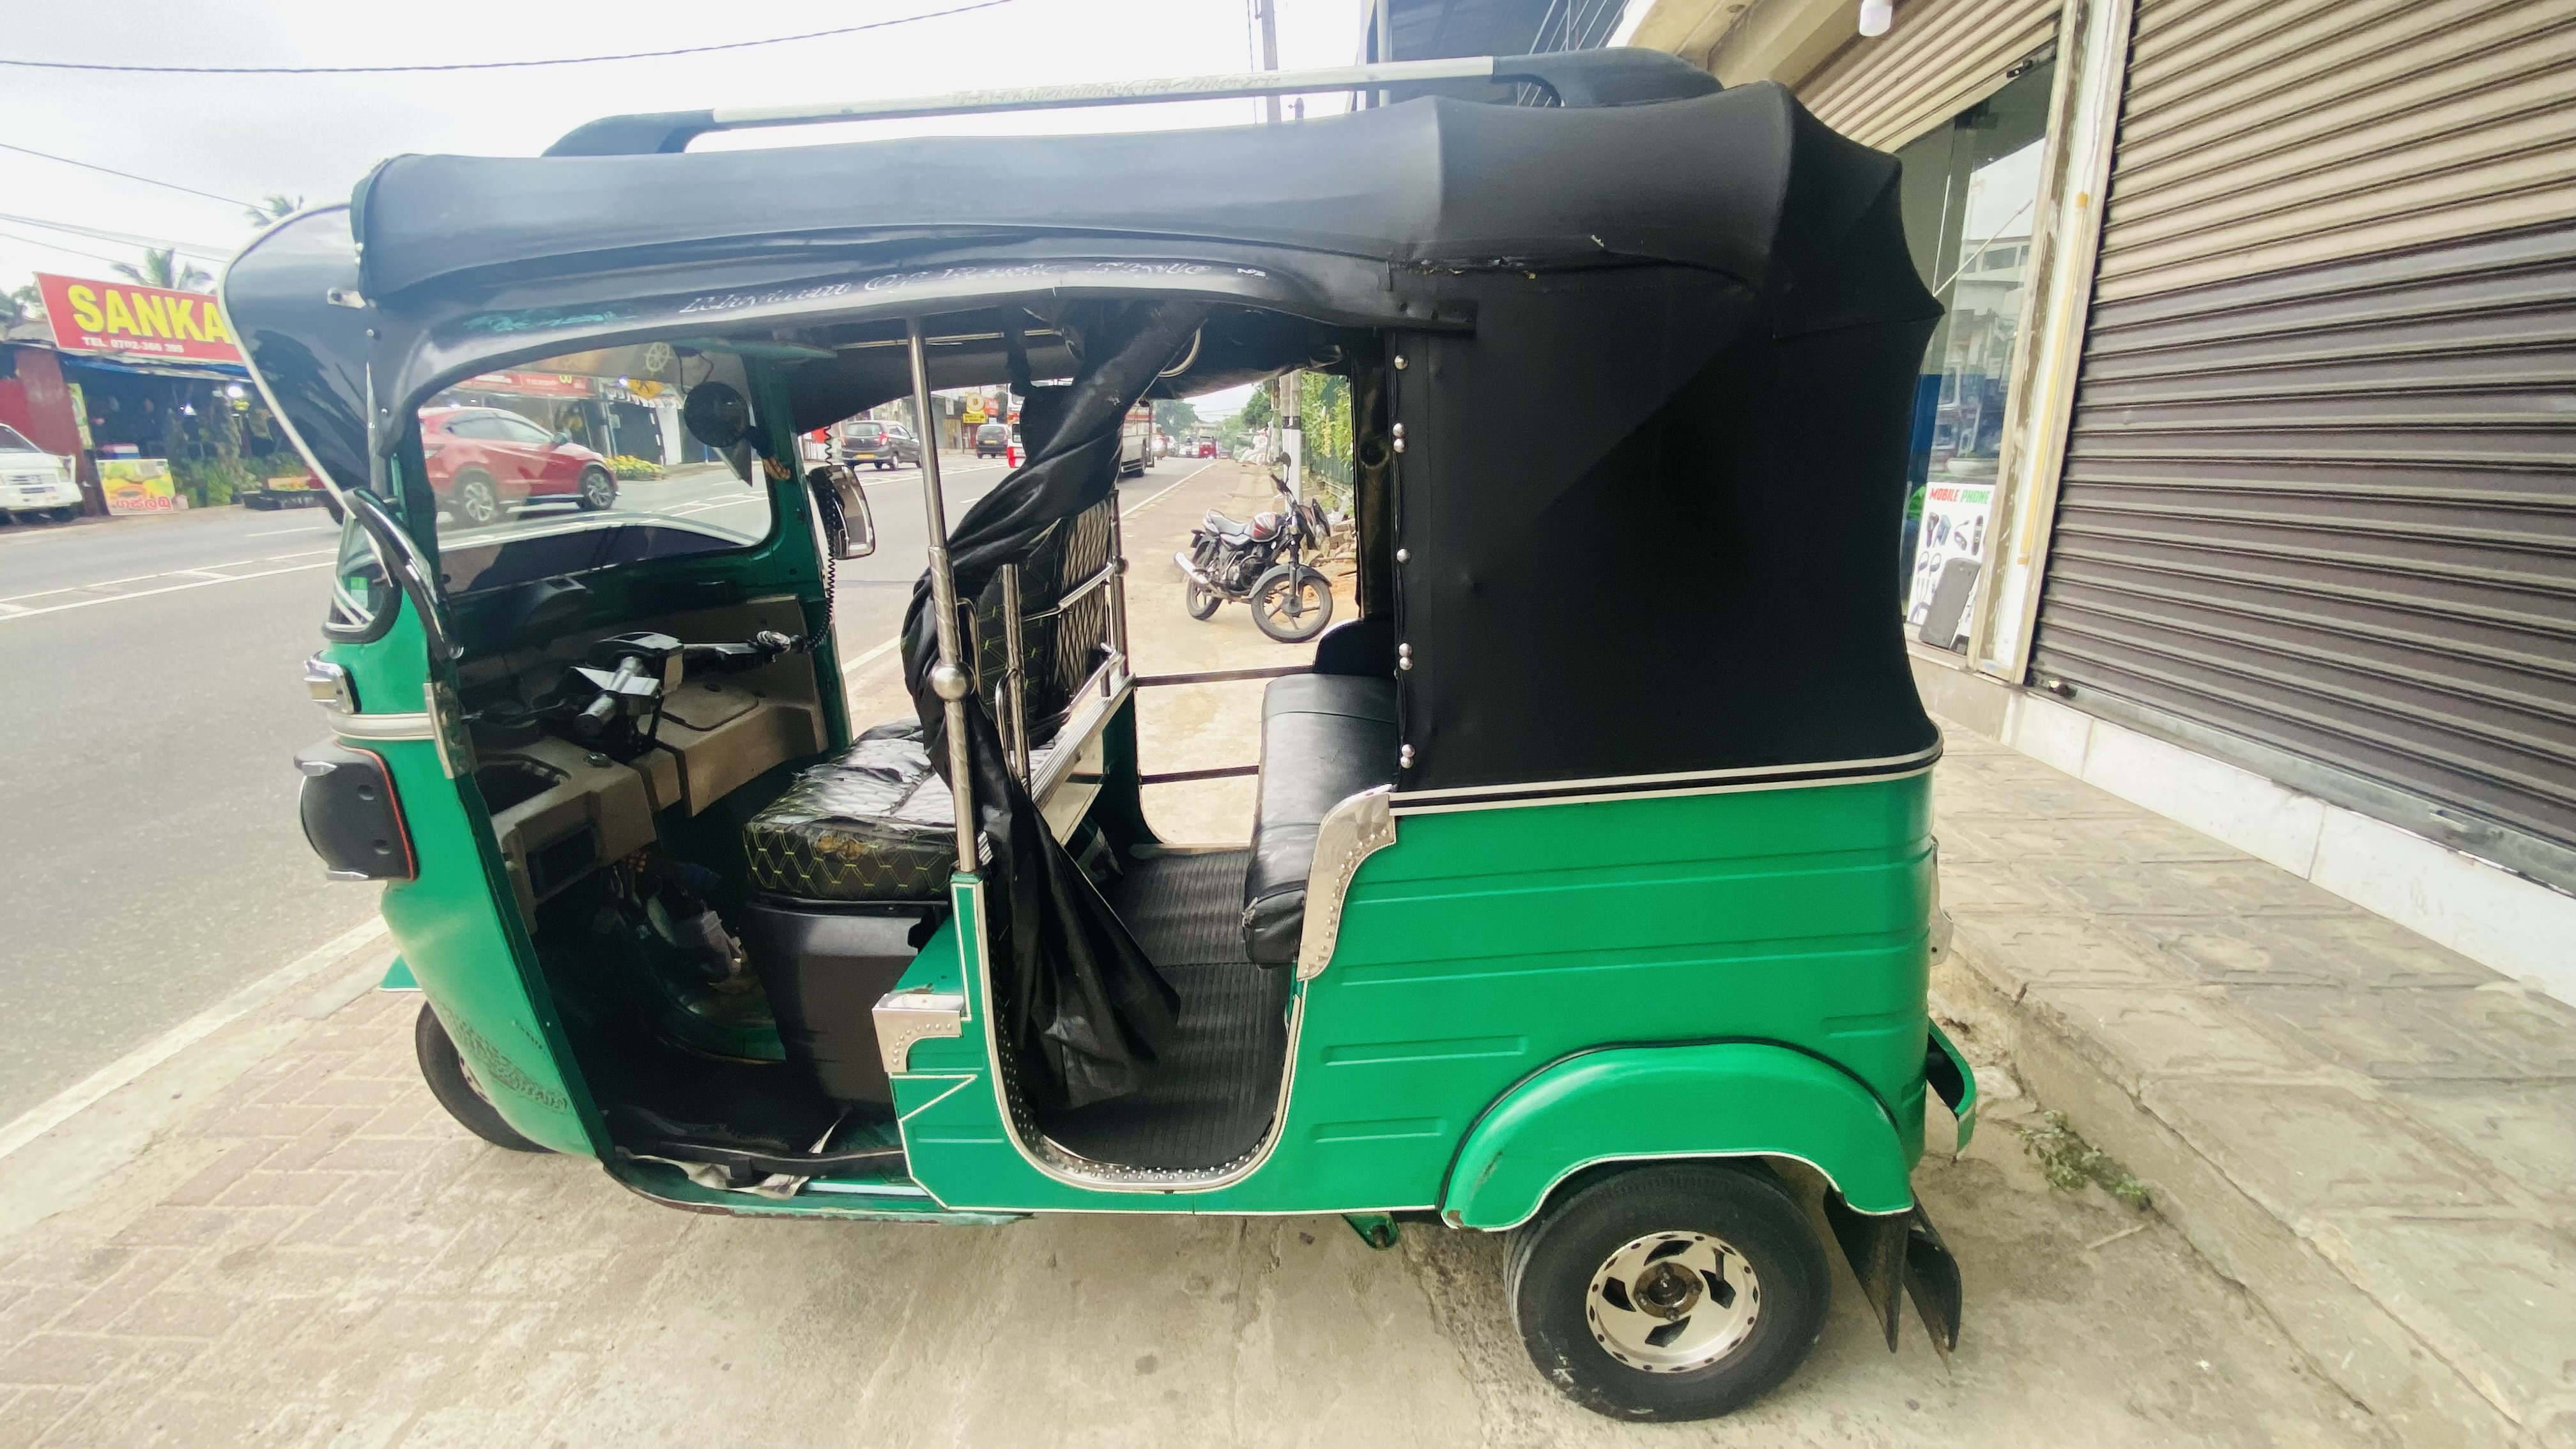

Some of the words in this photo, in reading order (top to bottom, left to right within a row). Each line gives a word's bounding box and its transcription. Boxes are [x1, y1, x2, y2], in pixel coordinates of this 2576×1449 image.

[68, 284, 234, 344] SANKA
[1929, 488, 1959, 502] MOBILE
[1960, 489, 1990, 504] PHONE
